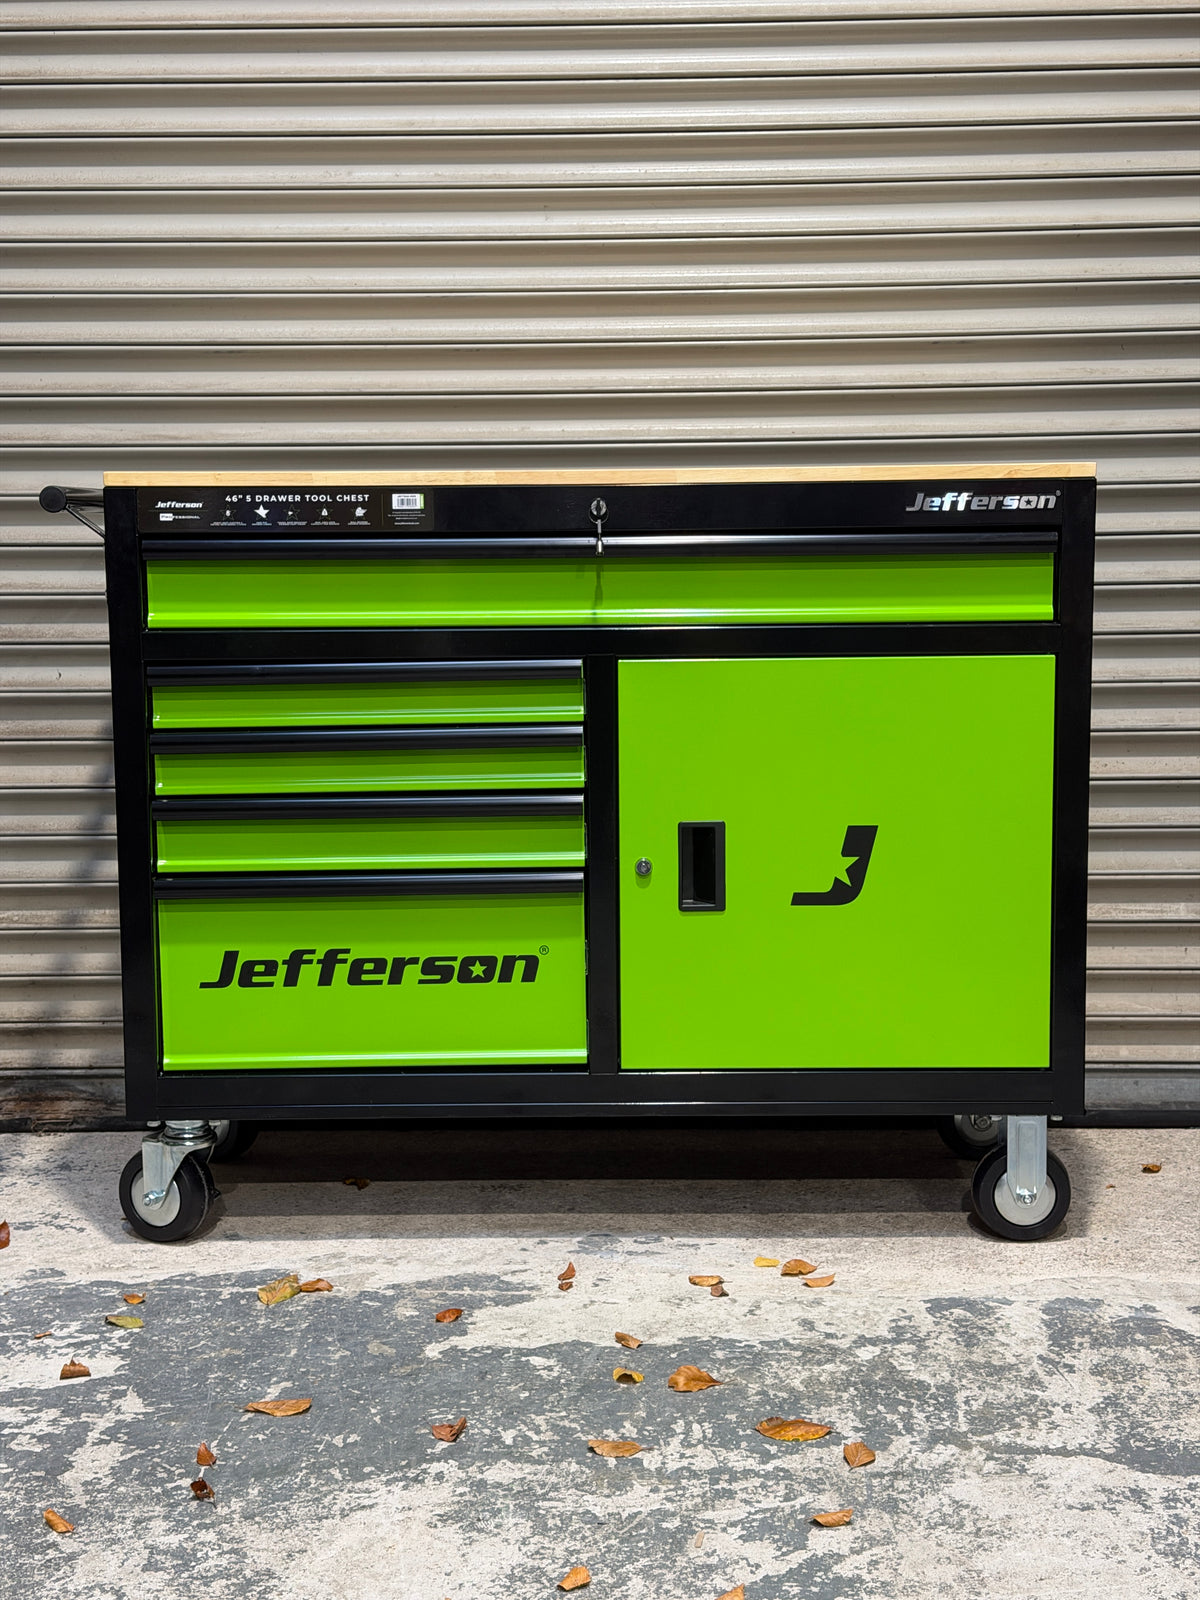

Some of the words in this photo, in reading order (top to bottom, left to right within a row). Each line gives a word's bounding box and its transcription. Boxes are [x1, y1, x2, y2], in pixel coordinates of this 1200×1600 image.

[245, 494, 252, 502] 5
[255, 494, 301, 503] DRAWER
[305, 494, 333, 502] TOOL
[336, 494, 370, 502] CHEST
